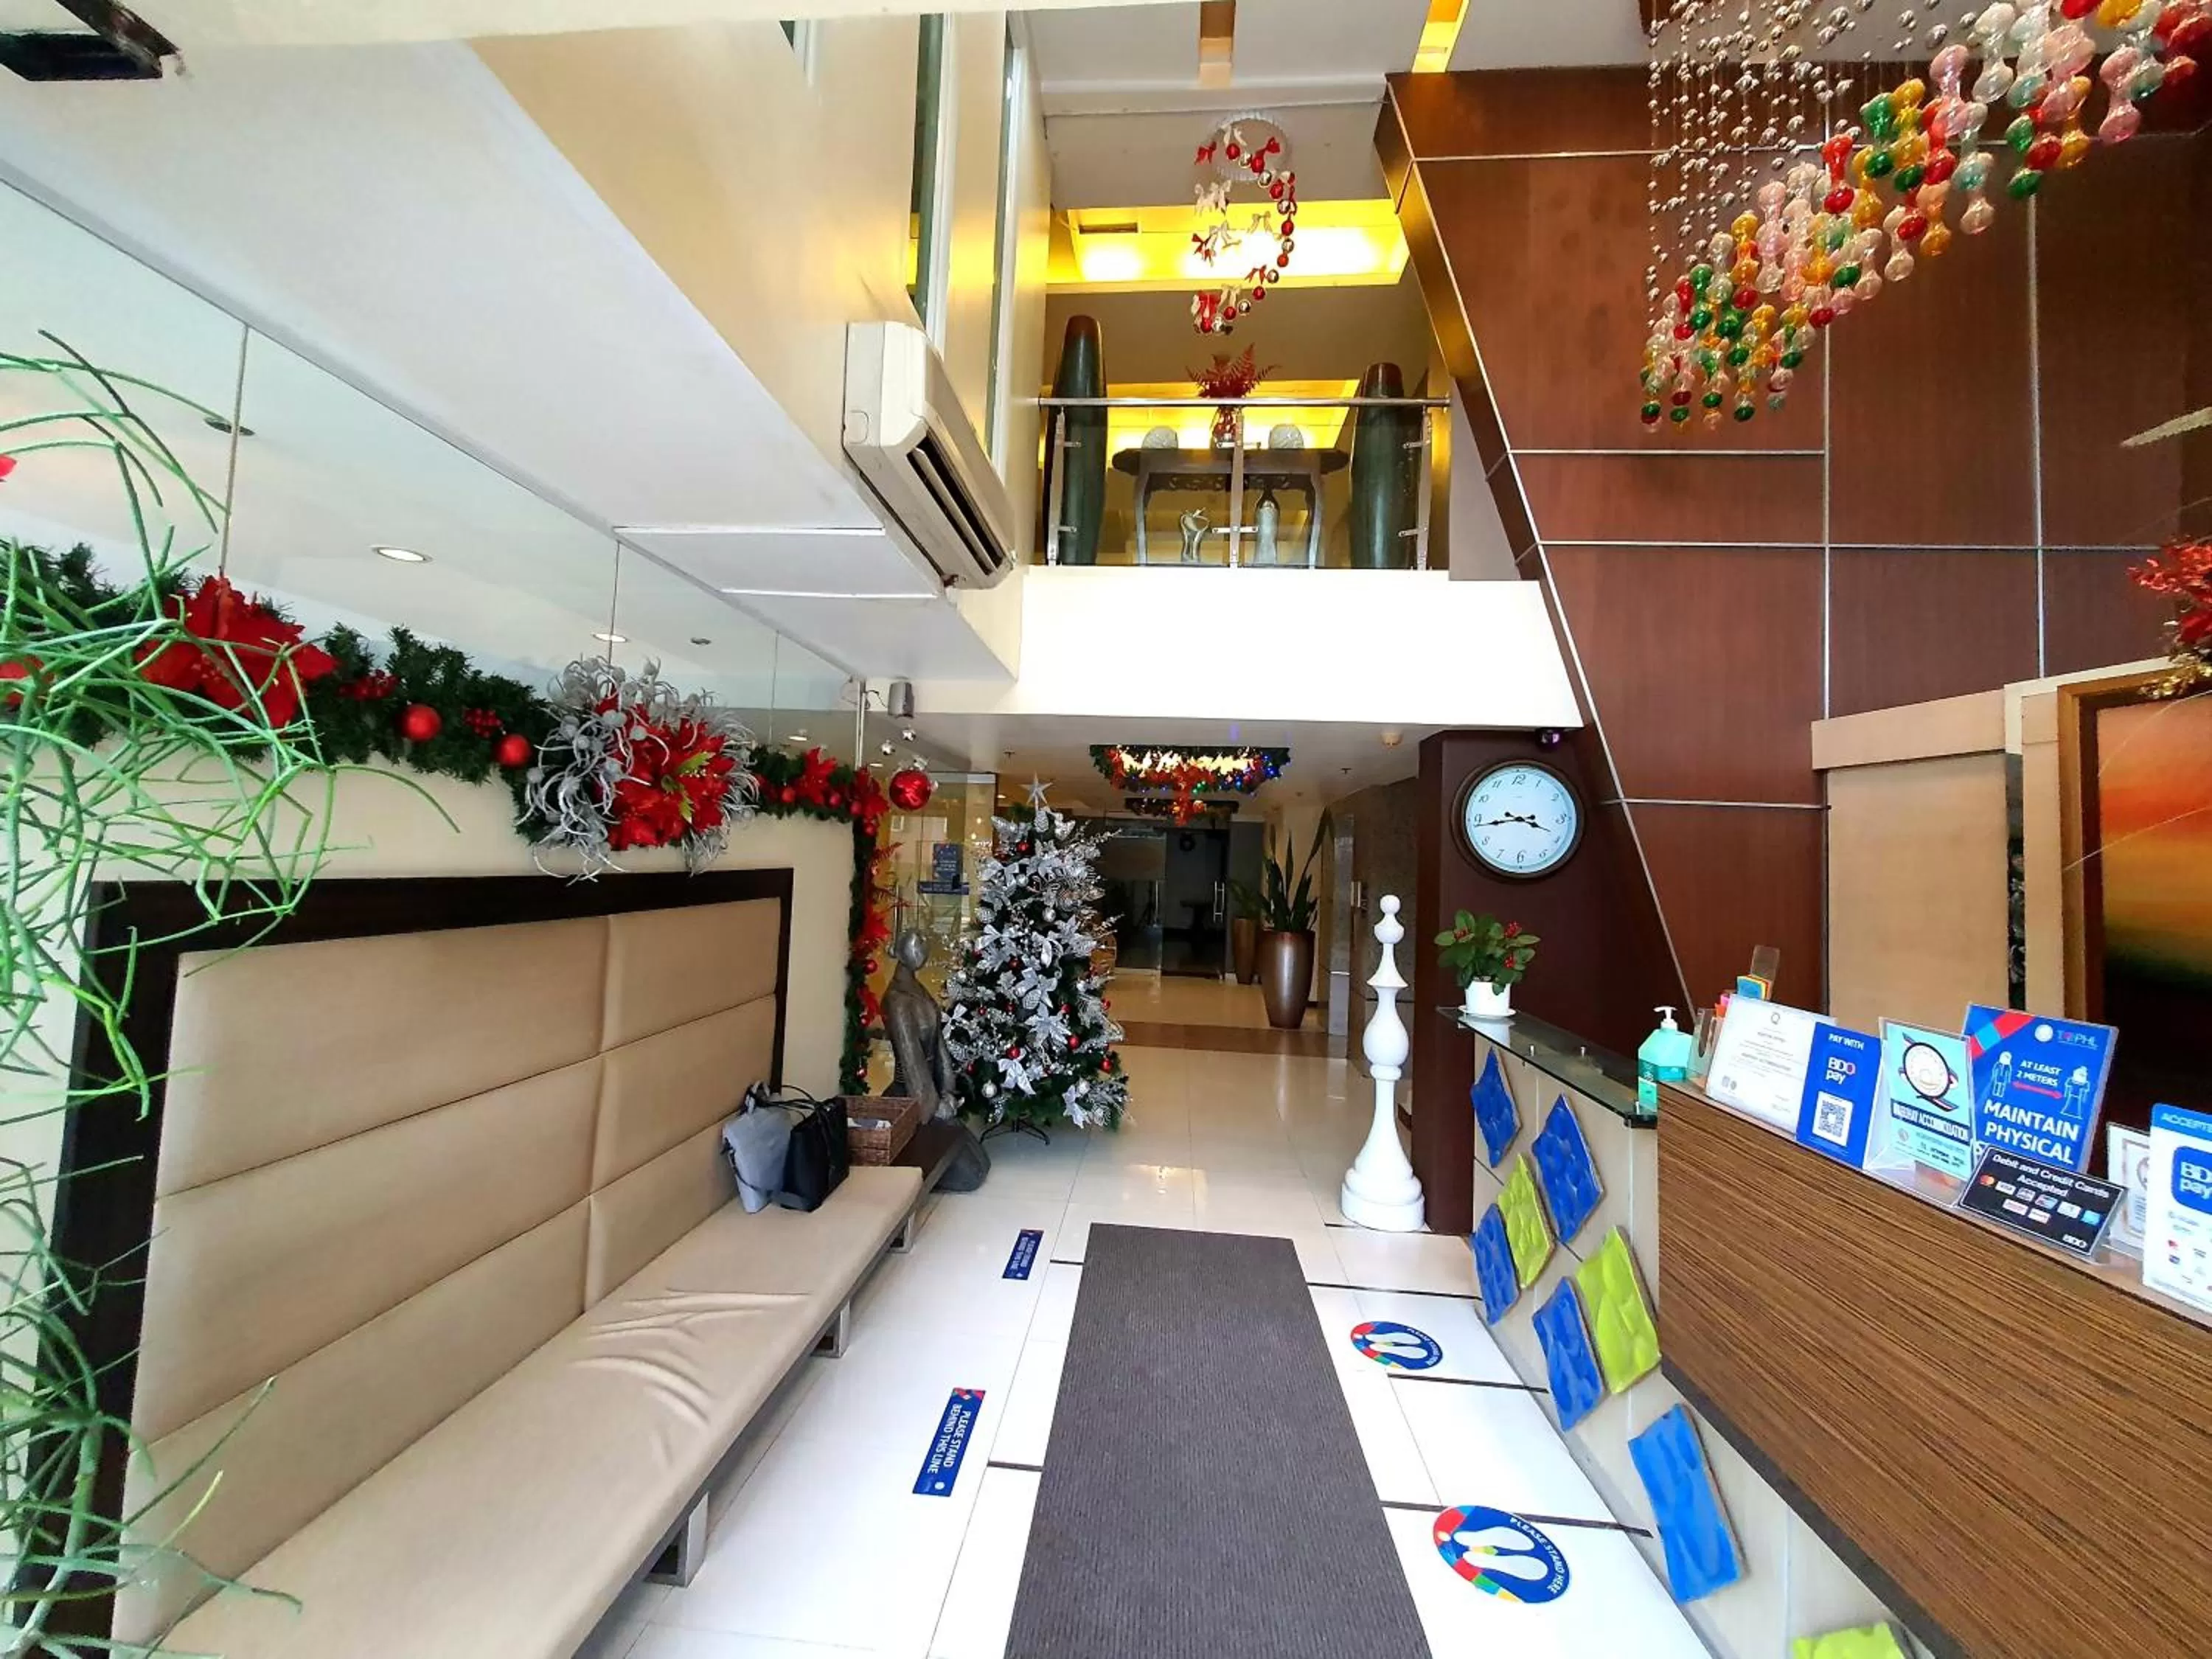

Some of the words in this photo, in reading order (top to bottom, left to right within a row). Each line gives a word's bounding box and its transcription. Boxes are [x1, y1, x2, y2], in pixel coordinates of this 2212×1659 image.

[1492, 779, 1502, 788] 11
[1512, 774, 1526, 785] 12
[1535, 779, 1542, 789] 1
[1478, 793, 1489, 803] 10
[1551, 793, 1559, 801] 2
[1475, 813, 1482, 823] 9
[1556, 813, 1567, 824] 3
[1482, 836, 1490, 845] 8
[1496, 849, 1505, 859] 7
[1517, 849, 1526, 863] 6
[1540, 849, 1548, 858] 5
[1828, 1033, 1840, 1044] PAY
[1842, 1038, 1865, 1051] WITH
[1828, 1057, 1856, 1075] BDO
[2020, 1060, 2033, 1068] AT
[2034, 1062, 2063, 1075] LEAST
[1825, 1069, 1846, 1085] pay
[2023, 1071, 2059, 1088] METERS
[1983, 1099, 2081, 1141] MAINTAIN
[1984, 1121, 2074, 1165] PHYSICAL
[1992, 1154, 2019, 1169] Debit
[2019, 1163, 2040, 1176] and
[2040, 1166, 2075, 1187] Credit
[2074, 1180, 2110, 1199] Cards
[2017, 1174, 2069, 1197] Accepted
[2180, 1177, 2212, 1200] pay
[943, 1403, 962, 1433] BEHIND
[953, 1411, 971, 1439] PLEASE
[936, 1433, 952, 1453] THIS
[943, 1438, 961, 1468] STAND
[927, 1453, 944, 1475] LINE
[1510, 1517, 1548, 1545] PLEASE
[1543, 1544, 1565, 1573] STAND
[1546, 1573, 1564, 1594] HERE
